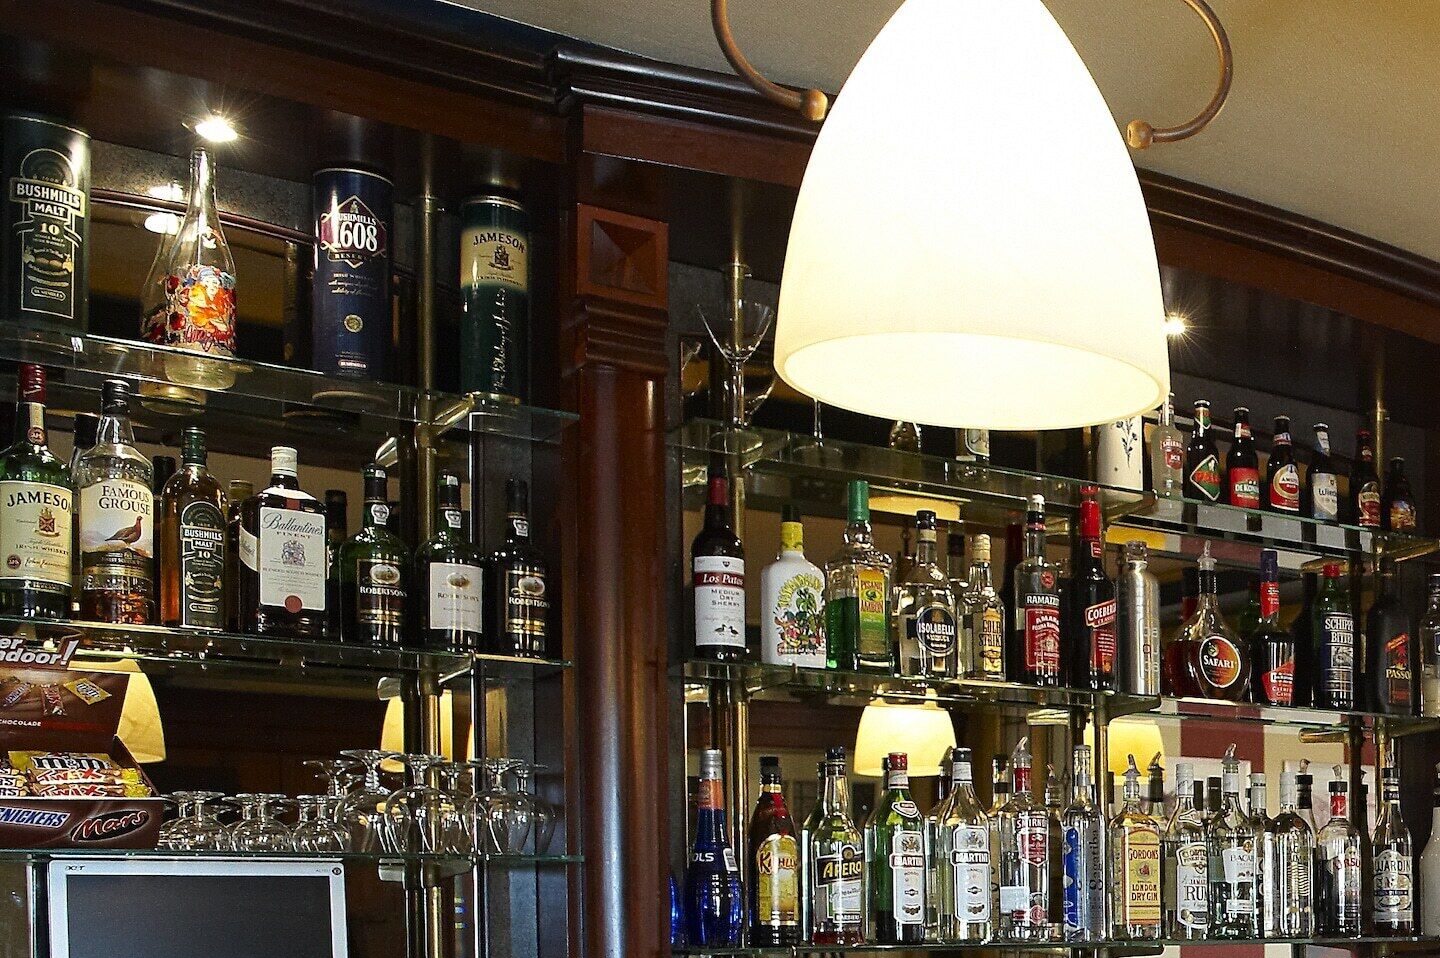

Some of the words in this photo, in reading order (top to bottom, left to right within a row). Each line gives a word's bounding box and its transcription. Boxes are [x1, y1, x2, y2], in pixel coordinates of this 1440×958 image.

[16, 183, 81, 209] BUSHMILLS
[34, 202, 66, 218] MALT
[335, 212, 377, 226] USHMILLS
[40, 222, 61, 236] 10
[333, 222, 378, 252] 1608
[473, 232, 525, 254] JAMESON
[102, 485, 150, 503] FAMOUS
[98, 497, 151, 515] GROUSE
[184, 528, 223, 541] BUSHMILLS
[194, 541, 214, 549] MALT
[198, 551, 211, 559] 10
[703, 573, 720, 583] Los
[711, 588, 740, 596] MEDIUM
[861, 601, 883, 613] AMBON
[918, 622, 955, 636] ISOLABELLA
[1203, 655, 1235, 669] SAFARI
[71, 810, 148, 842] Mars
[1132, 884, 1157, 892] LONDON
[1131, 892, 1146, 901] DRY
[1147, 892, 1158, 901] GIN
